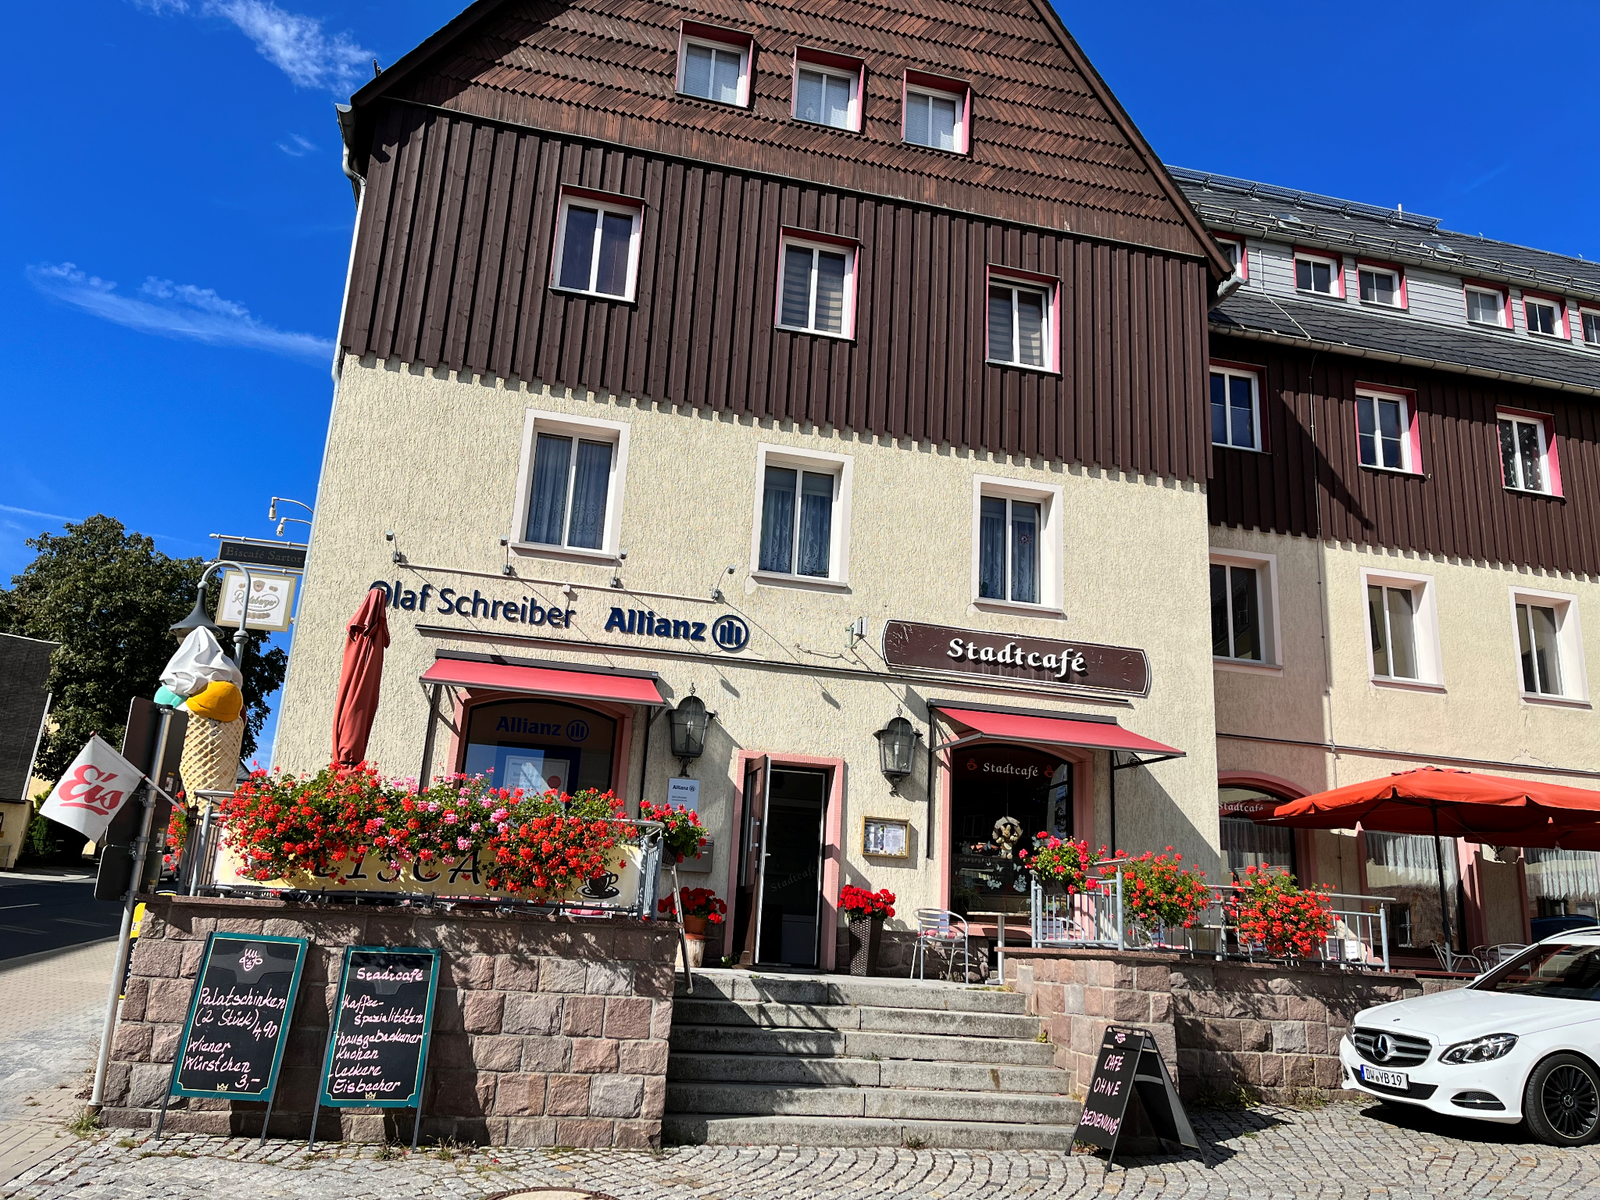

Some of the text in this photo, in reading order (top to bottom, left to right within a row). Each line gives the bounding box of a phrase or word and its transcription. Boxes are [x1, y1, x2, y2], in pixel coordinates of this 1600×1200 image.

[225, 546, 303, 564] Eiscafé Sartor
[437, 587, 577, 629] Schreiber
[604, 606, 707, 642] Allianz
[946, 637, 1087, 679] Stadtcafé
[495, 716, 562, 737] Allianz
[982, 762, 1039, 780] Stadtcafé
[58, 764, 124, 810] Eis
[771, 860, 818, 893] Stadtcafé
[199, 986, 286, 1010] Palatschinken
[187, 1035, 232, 1054] Wiener
[183, 1054, 252, 1074] Würstchen
[1093, 1077, 1122, 1097] OHNE
[1080, 1107, 1121, 1136] BEDIENUNG
